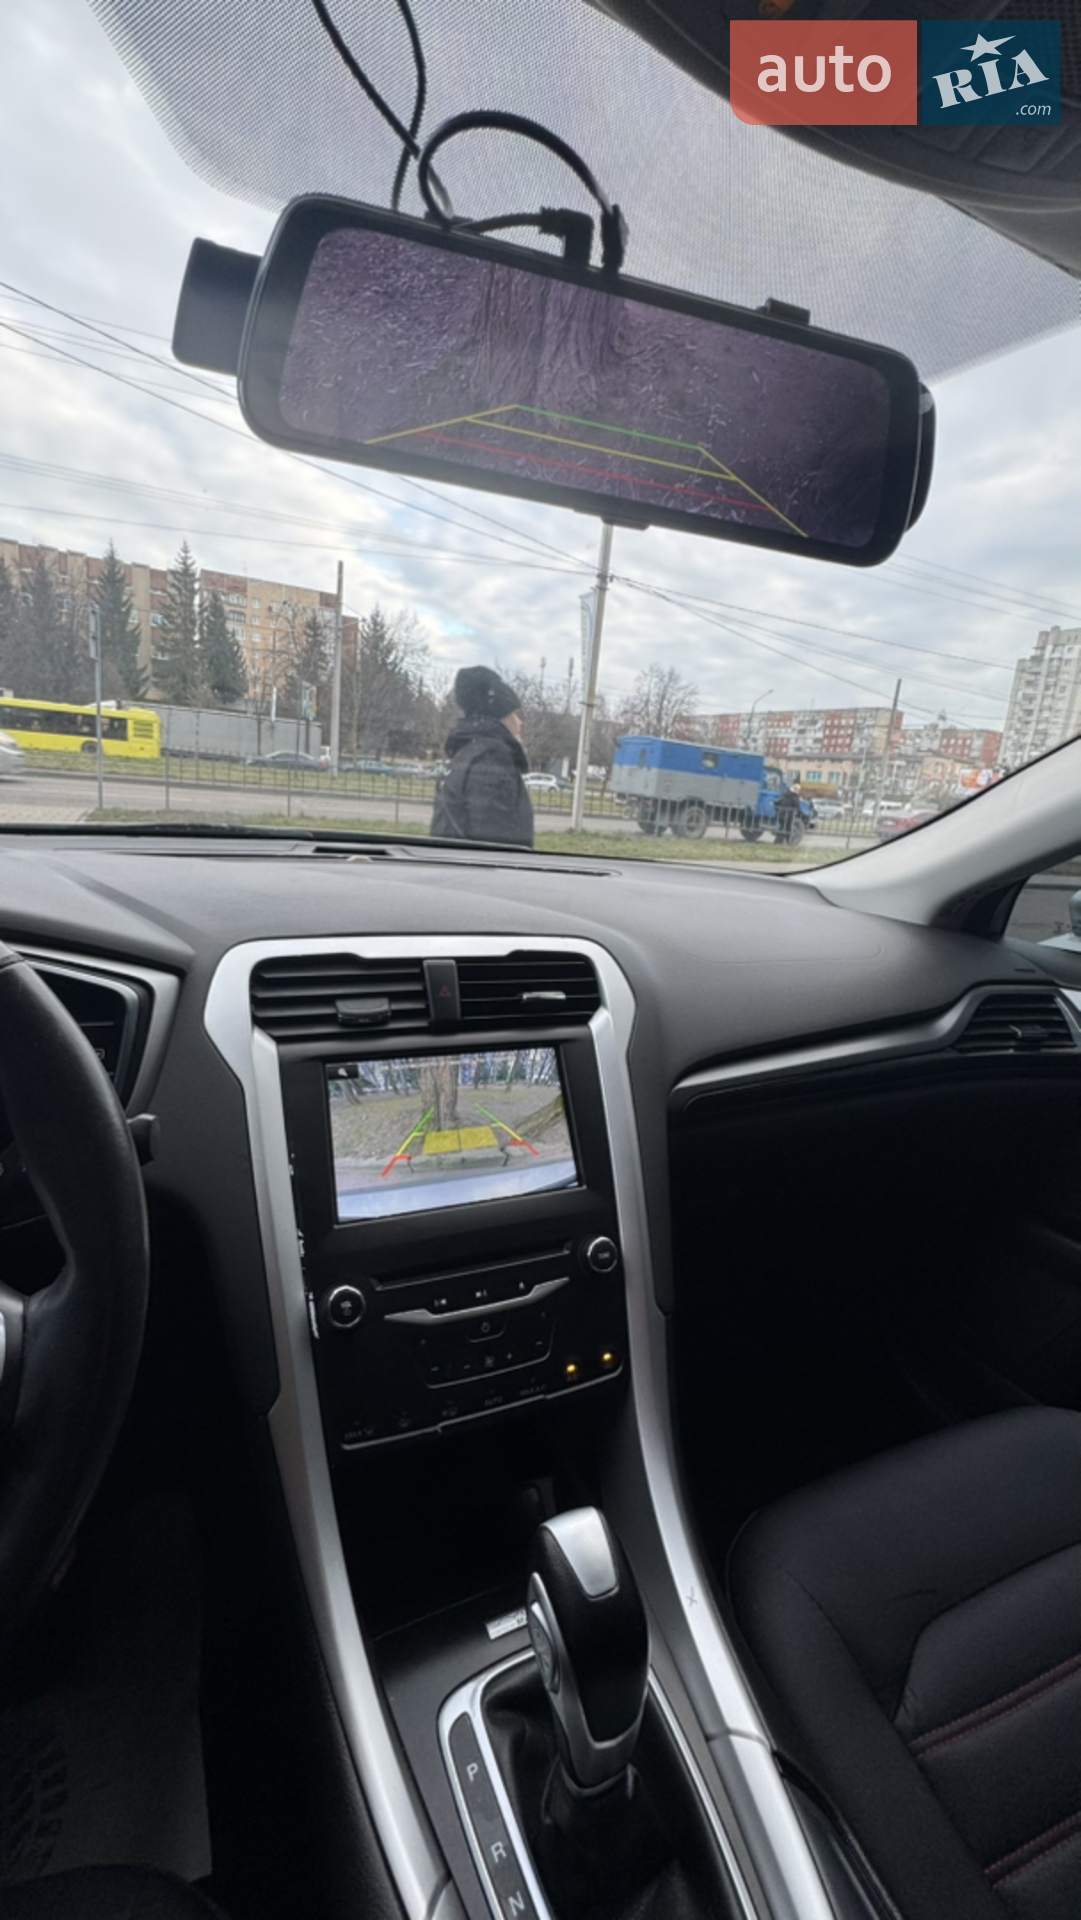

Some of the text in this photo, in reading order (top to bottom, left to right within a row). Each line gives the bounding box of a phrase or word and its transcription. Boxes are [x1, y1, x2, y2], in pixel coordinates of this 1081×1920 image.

[466, 1762, 479, 1782] P
[490, 1841, 507, 1863] R
[508, 1891, 526, 1917] N
